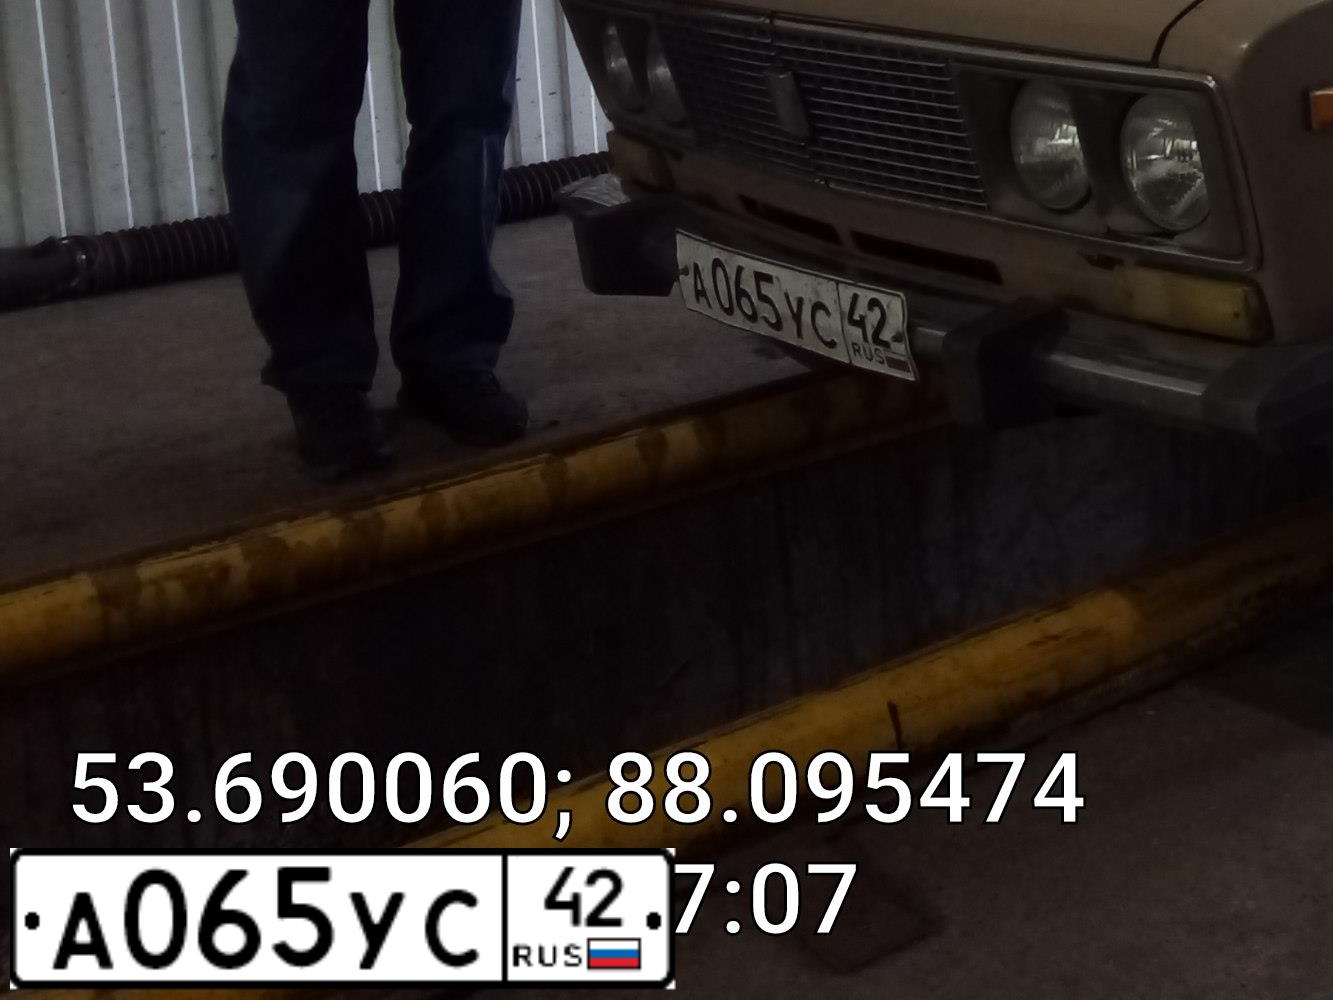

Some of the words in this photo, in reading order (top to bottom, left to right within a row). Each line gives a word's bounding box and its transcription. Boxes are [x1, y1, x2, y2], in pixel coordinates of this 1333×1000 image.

[693, 257, 837, 349] А065УС
[847, 292, 891, 348] 42
[851, 341, 885, 365] RUS
